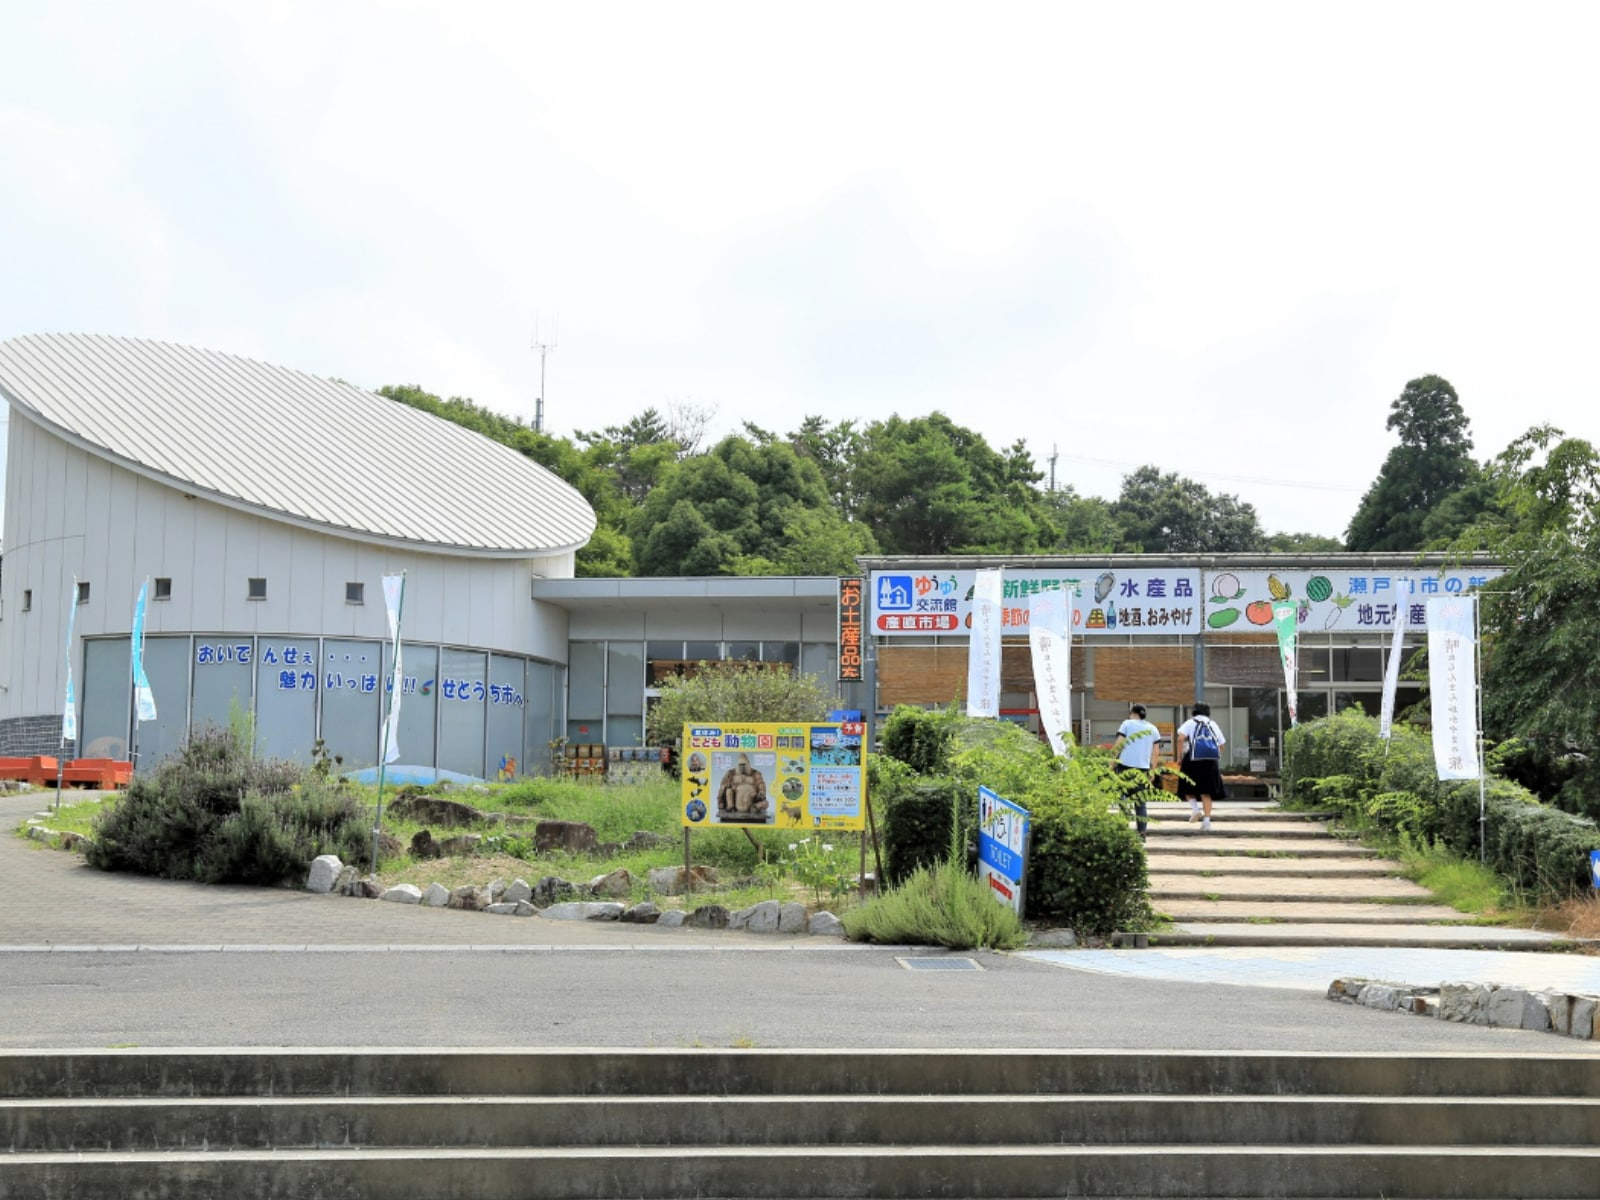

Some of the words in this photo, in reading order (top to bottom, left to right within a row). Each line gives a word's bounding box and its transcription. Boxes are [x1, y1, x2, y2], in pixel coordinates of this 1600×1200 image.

[915, 575, 958, 595] ゆうゆう
[1120, 578, 1192, 598] 水産品
[916, 598, 957, 612] 交流館
[1357, 603, 1426, 625] 地元産
[885, 616, 950, 629] 産直市場
[1119, 607, 1193, 627] 地酒、おみやげ
[692, 737, 721, 748] こども
[724, 734, 773, 749] 動物園
[990, 843, 1012, 872] TOILET
